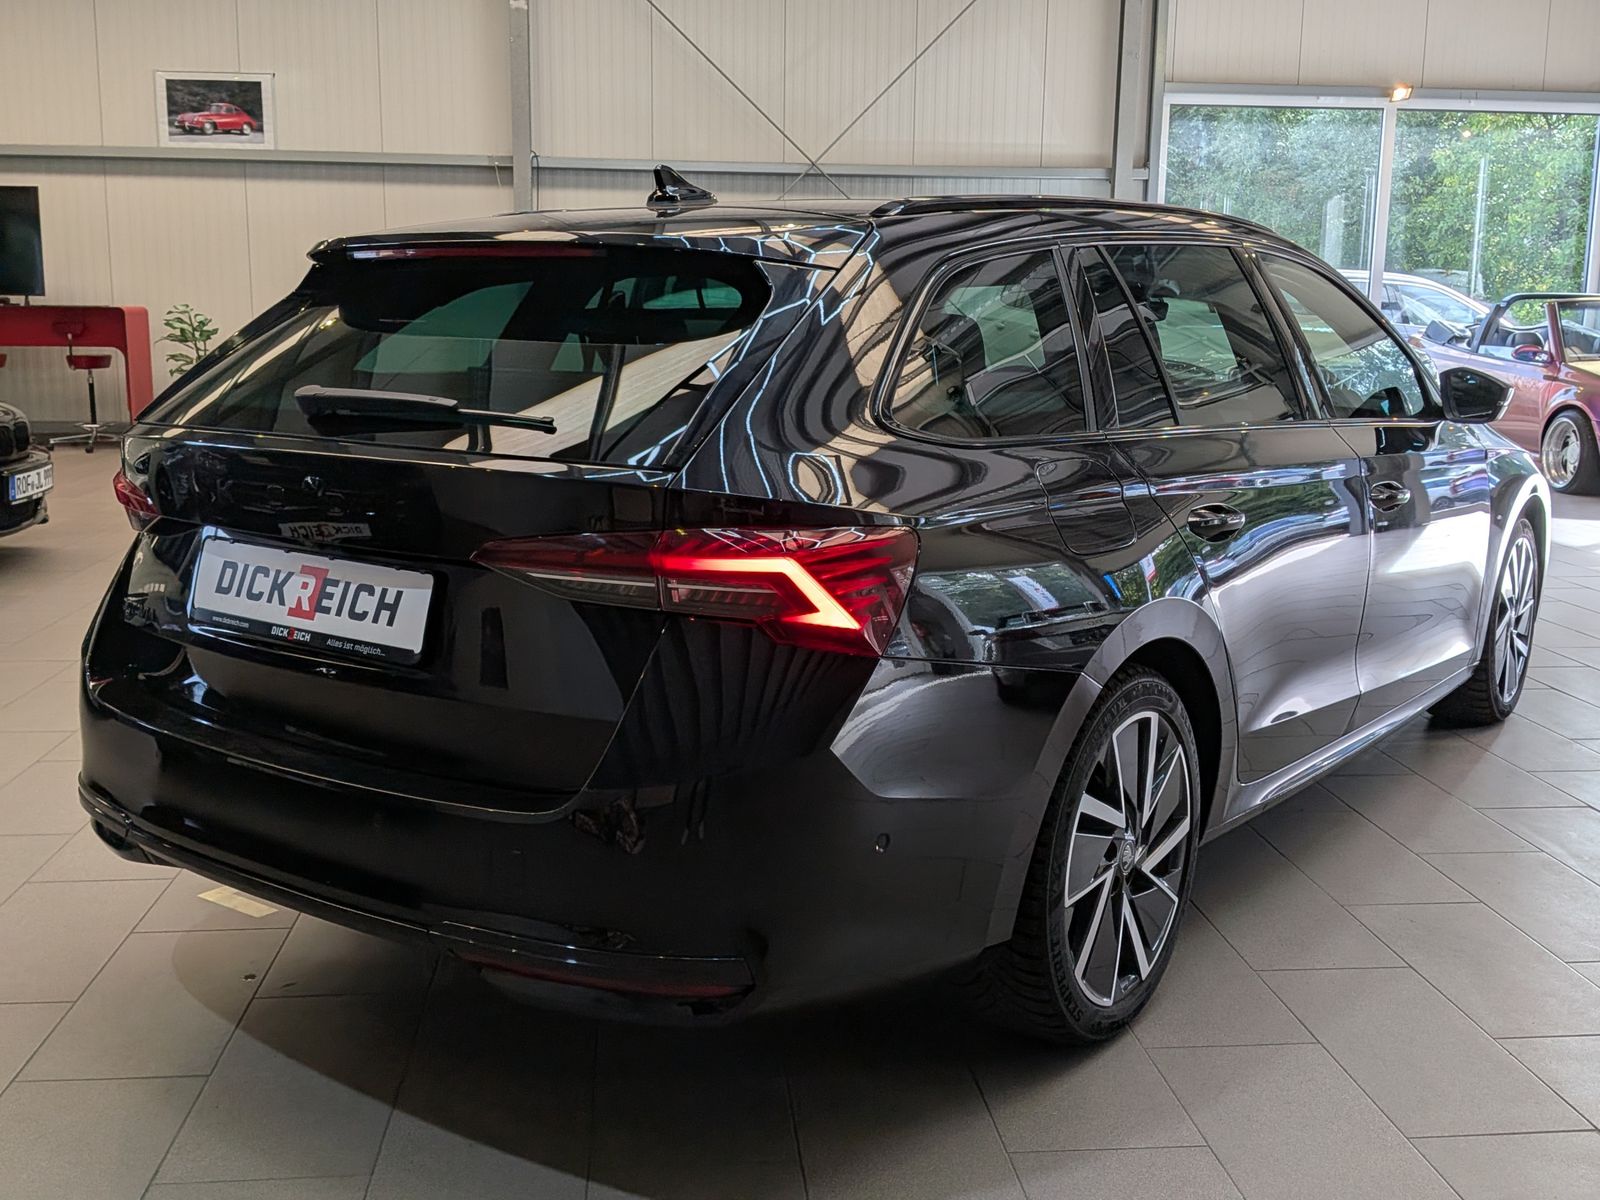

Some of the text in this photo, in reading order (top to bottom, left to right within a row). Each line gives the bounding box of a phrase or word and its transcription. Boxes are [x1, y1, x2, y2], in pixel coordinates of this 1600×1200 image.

[214, 560, 404, 627] DICKREICH
[326, 637, 343, 649] Alles
[343, 641, 354, 651] ist
